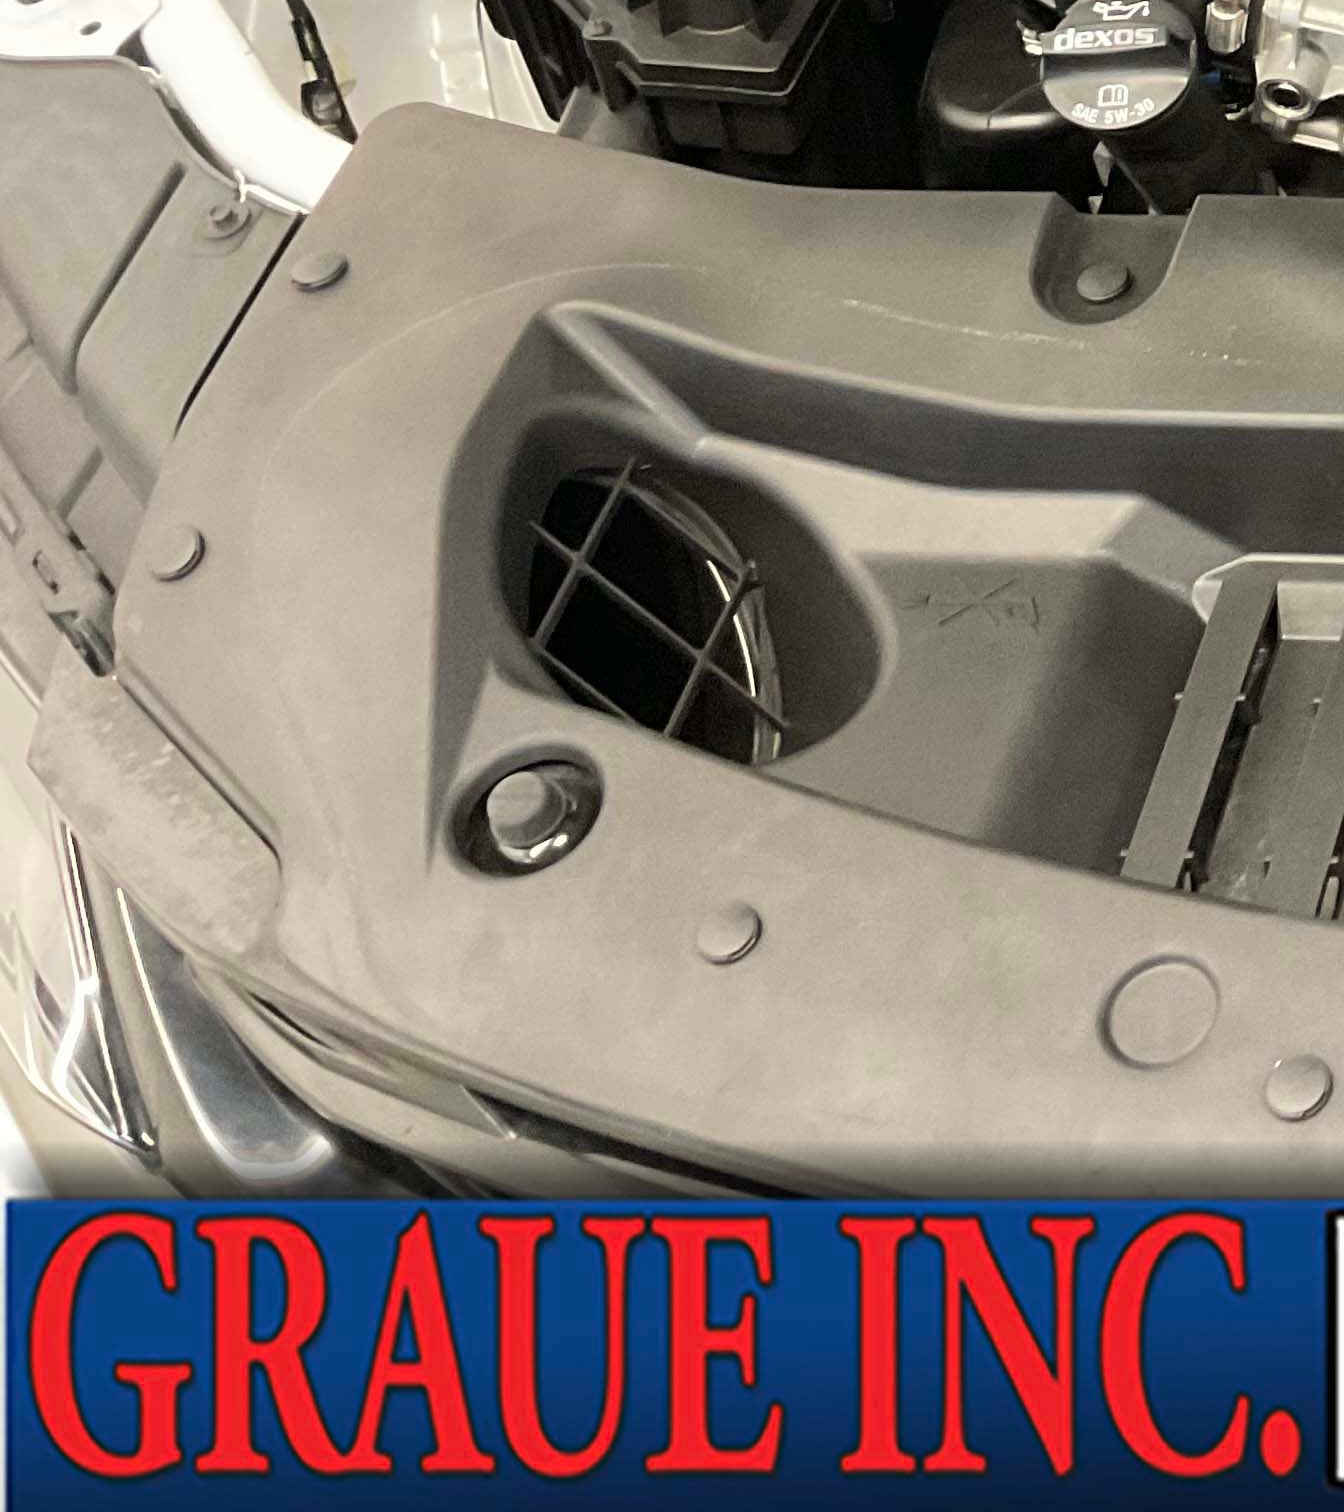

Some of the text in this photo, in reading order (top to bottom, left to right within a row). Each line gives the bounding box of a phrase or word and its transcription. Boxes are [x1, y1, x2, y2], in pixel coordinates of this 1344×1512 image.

[1053, 26, 1159, 51] dexos
[1071, 97, 1155, 125] SAE 5W-30
